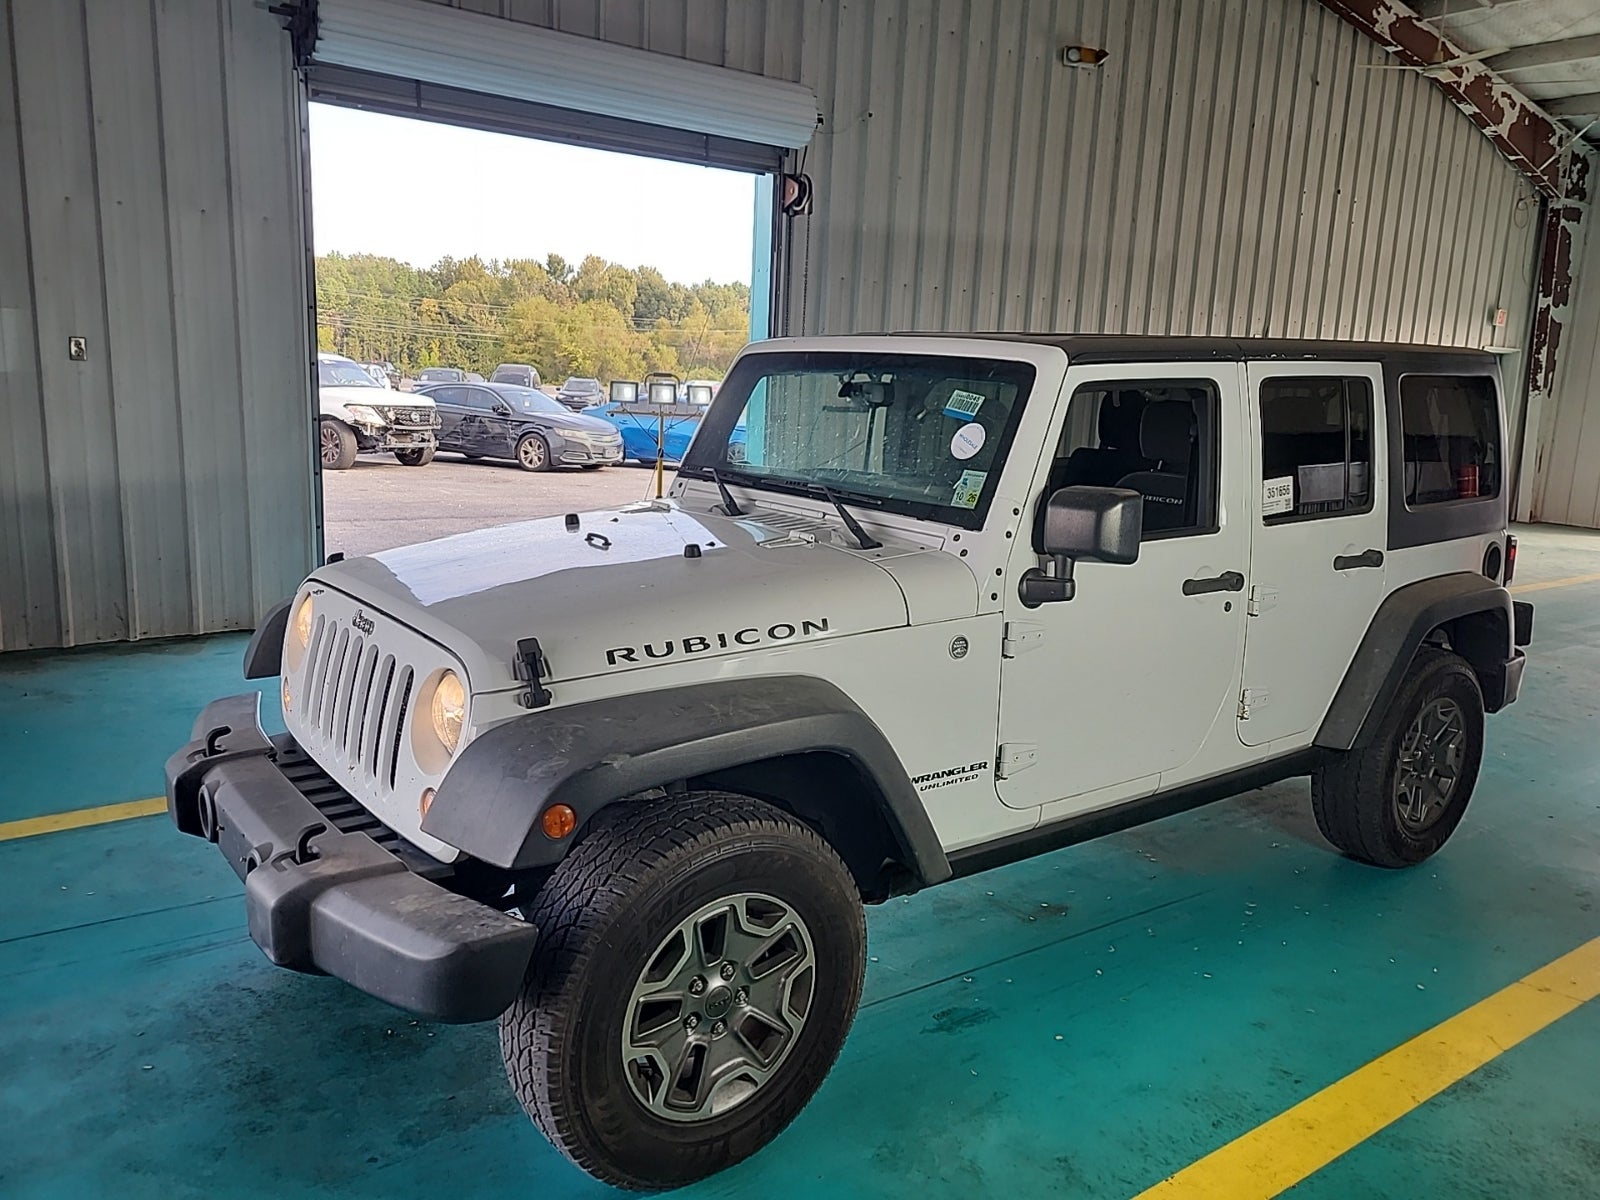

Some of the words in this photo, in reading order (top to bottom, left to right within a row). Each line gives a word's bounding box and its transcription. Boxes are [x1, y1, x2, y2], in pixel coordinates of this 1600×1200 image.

[955, 491, 964, 501] 10
[352, 609, 375, 637] Jeep
[605, 618, 829, 666] RUBICON
[911, 761, 988, 784] WRANGLER
[919, 773, 979, 792] UNLIMITED
